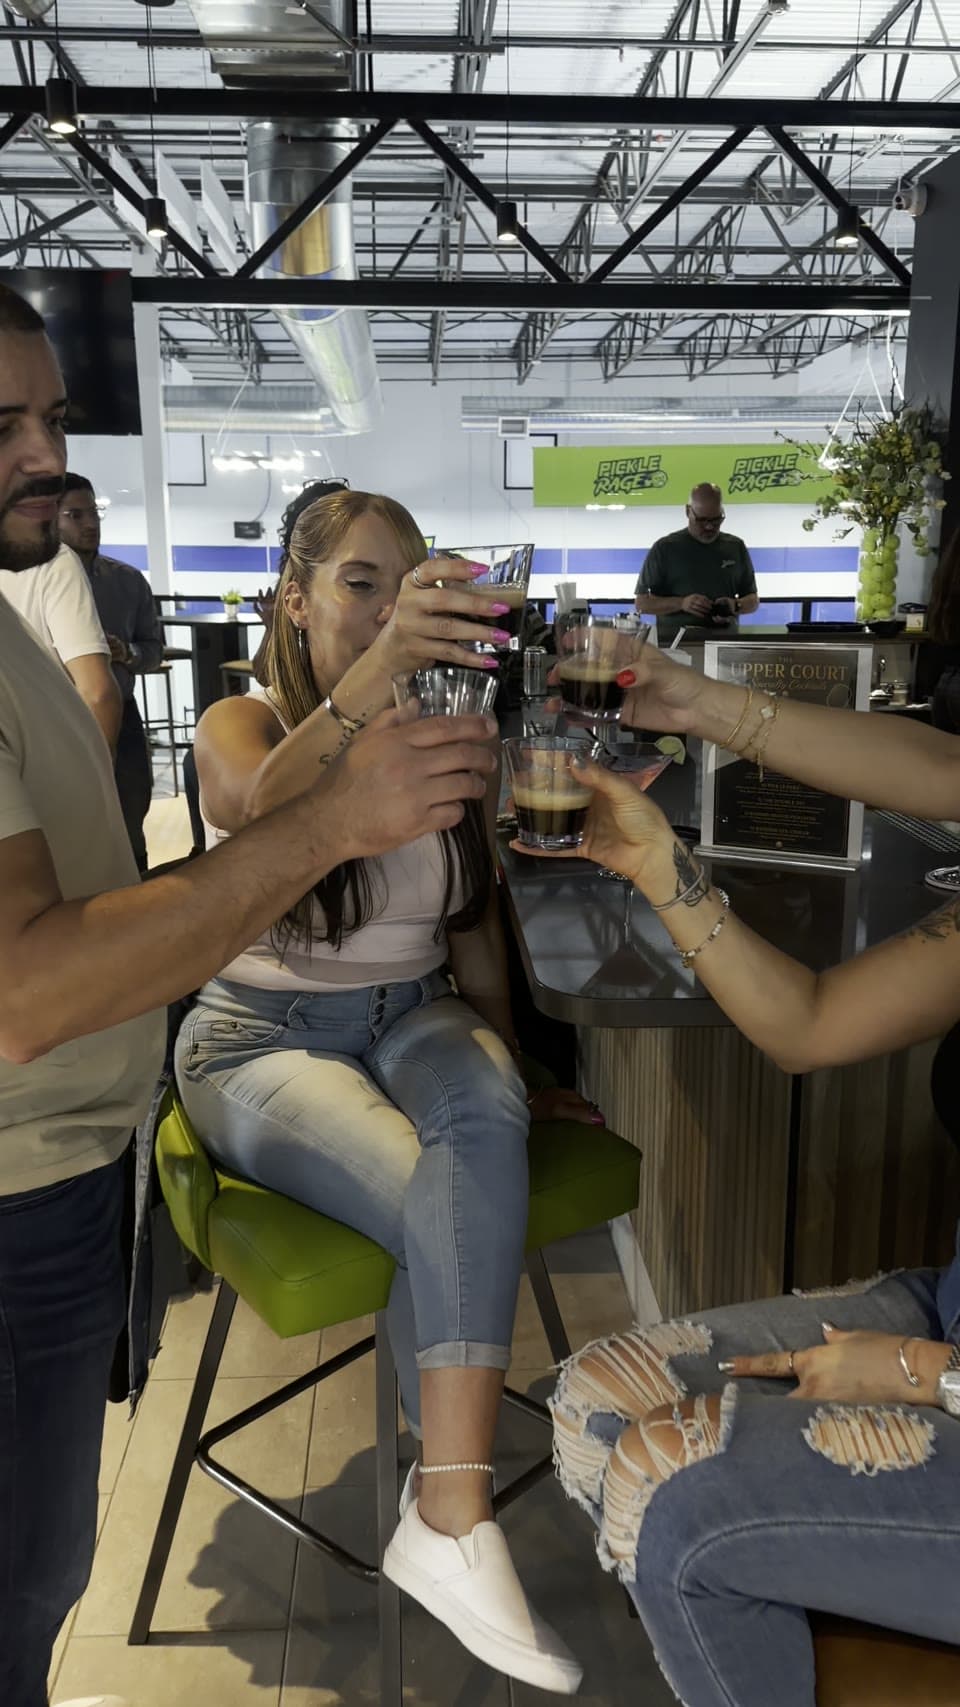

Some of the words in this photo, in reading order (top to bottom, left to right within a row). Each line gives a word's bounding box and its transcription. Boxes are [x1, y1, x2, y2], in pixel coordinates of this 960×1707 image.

[598, 455, 661, 477] PICKLE
[733, 454, 799, 475] PICKLE
[594, 473, 650, 496] RAGE
[728, 472, 784, 494] RAGE
[730, 662, 785, 678] UPPER
[790, 664, 848, 681] COURT
